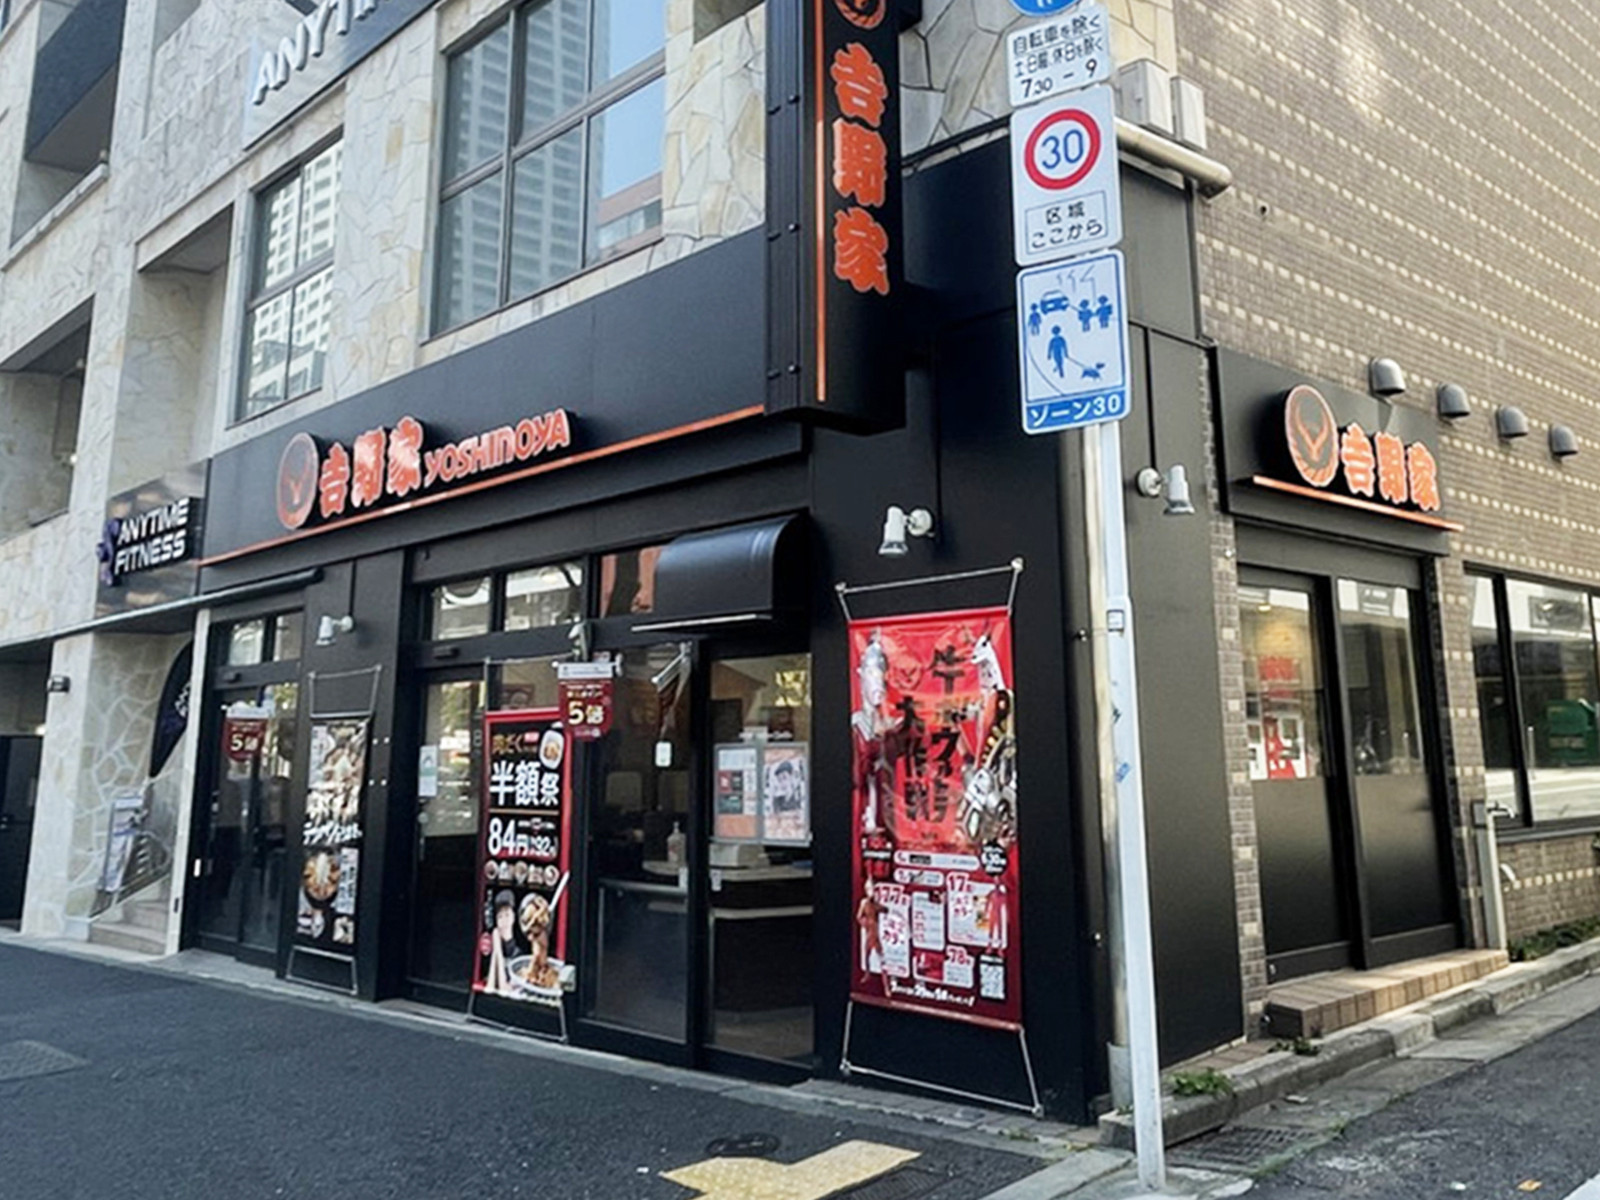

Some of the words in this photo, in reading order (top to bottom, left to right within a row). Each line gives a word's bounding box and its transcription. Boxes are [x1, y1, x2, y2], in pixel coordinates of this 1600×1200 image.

[1041, 129, 1084, 170] 30
[1031, 219, 1103, 249] ここから
[1046, 201, 1085, 225] 区域
[424, 408, 570, 488] YOSHINOYA
[117, 497, 190, 546] ANYTIME
[114, 528, 187, 576] FITNESS
[488, 759, 560, 807] 半額祭
